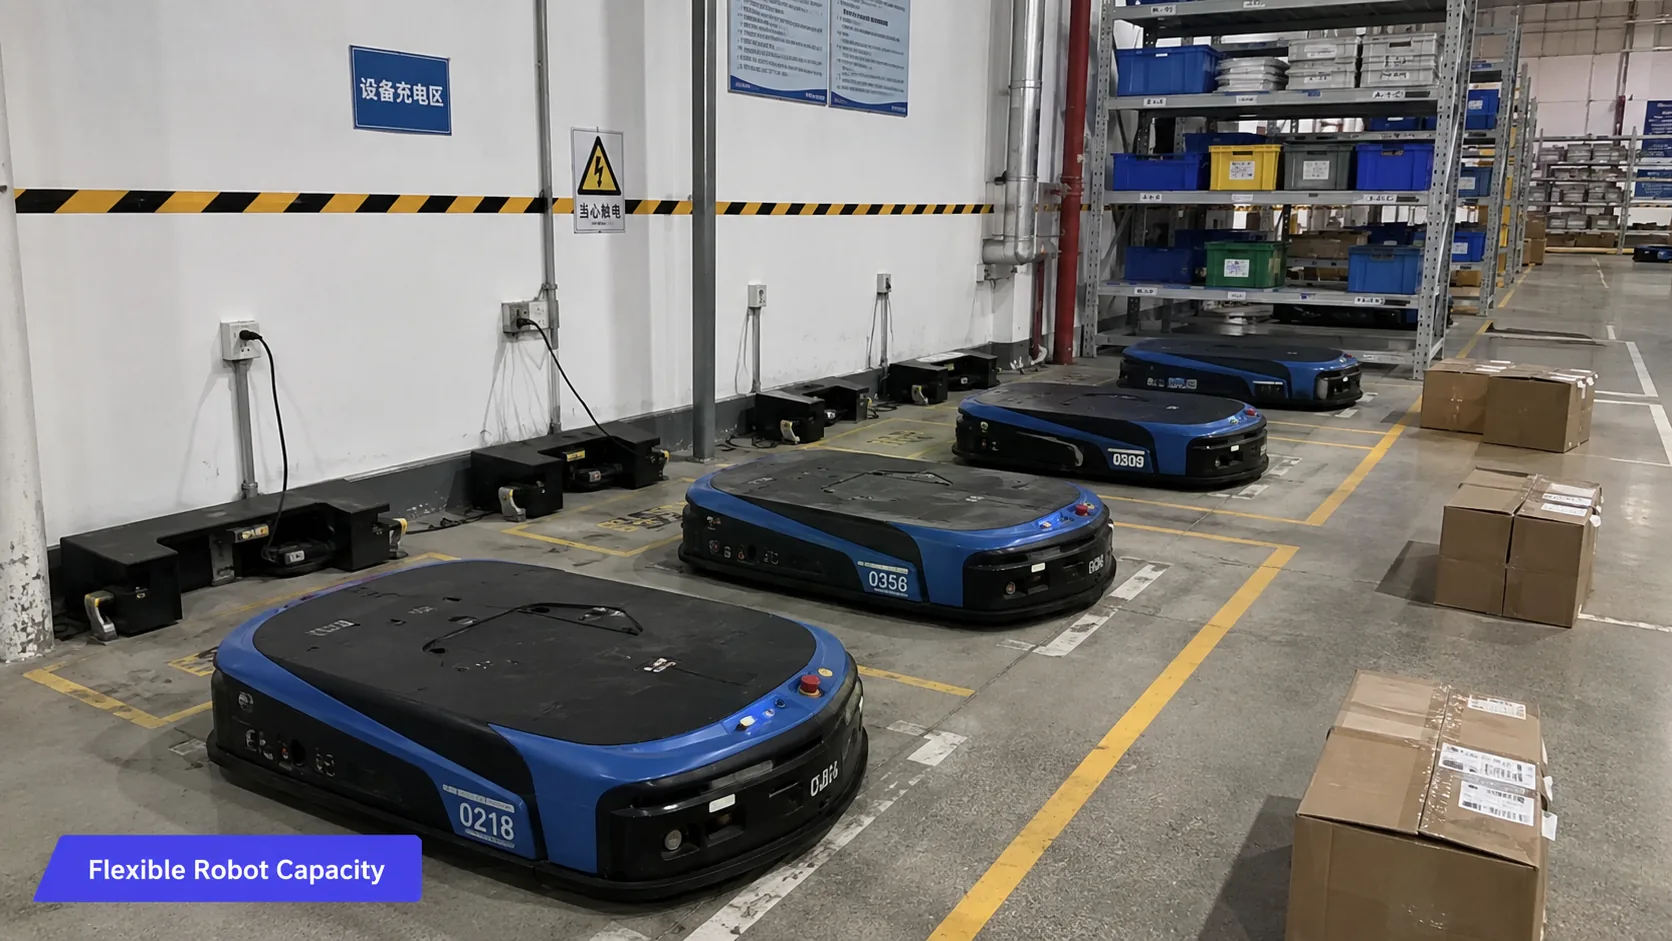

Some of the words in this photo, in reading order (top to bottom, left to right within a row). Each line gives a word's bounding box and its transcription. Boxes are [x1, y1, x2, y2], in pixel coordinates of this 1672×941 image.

[360, 77, 444, 106] 设备充电区
[868, 571, 907, 592] 0356
[460, 802, 514, 840] 0218
